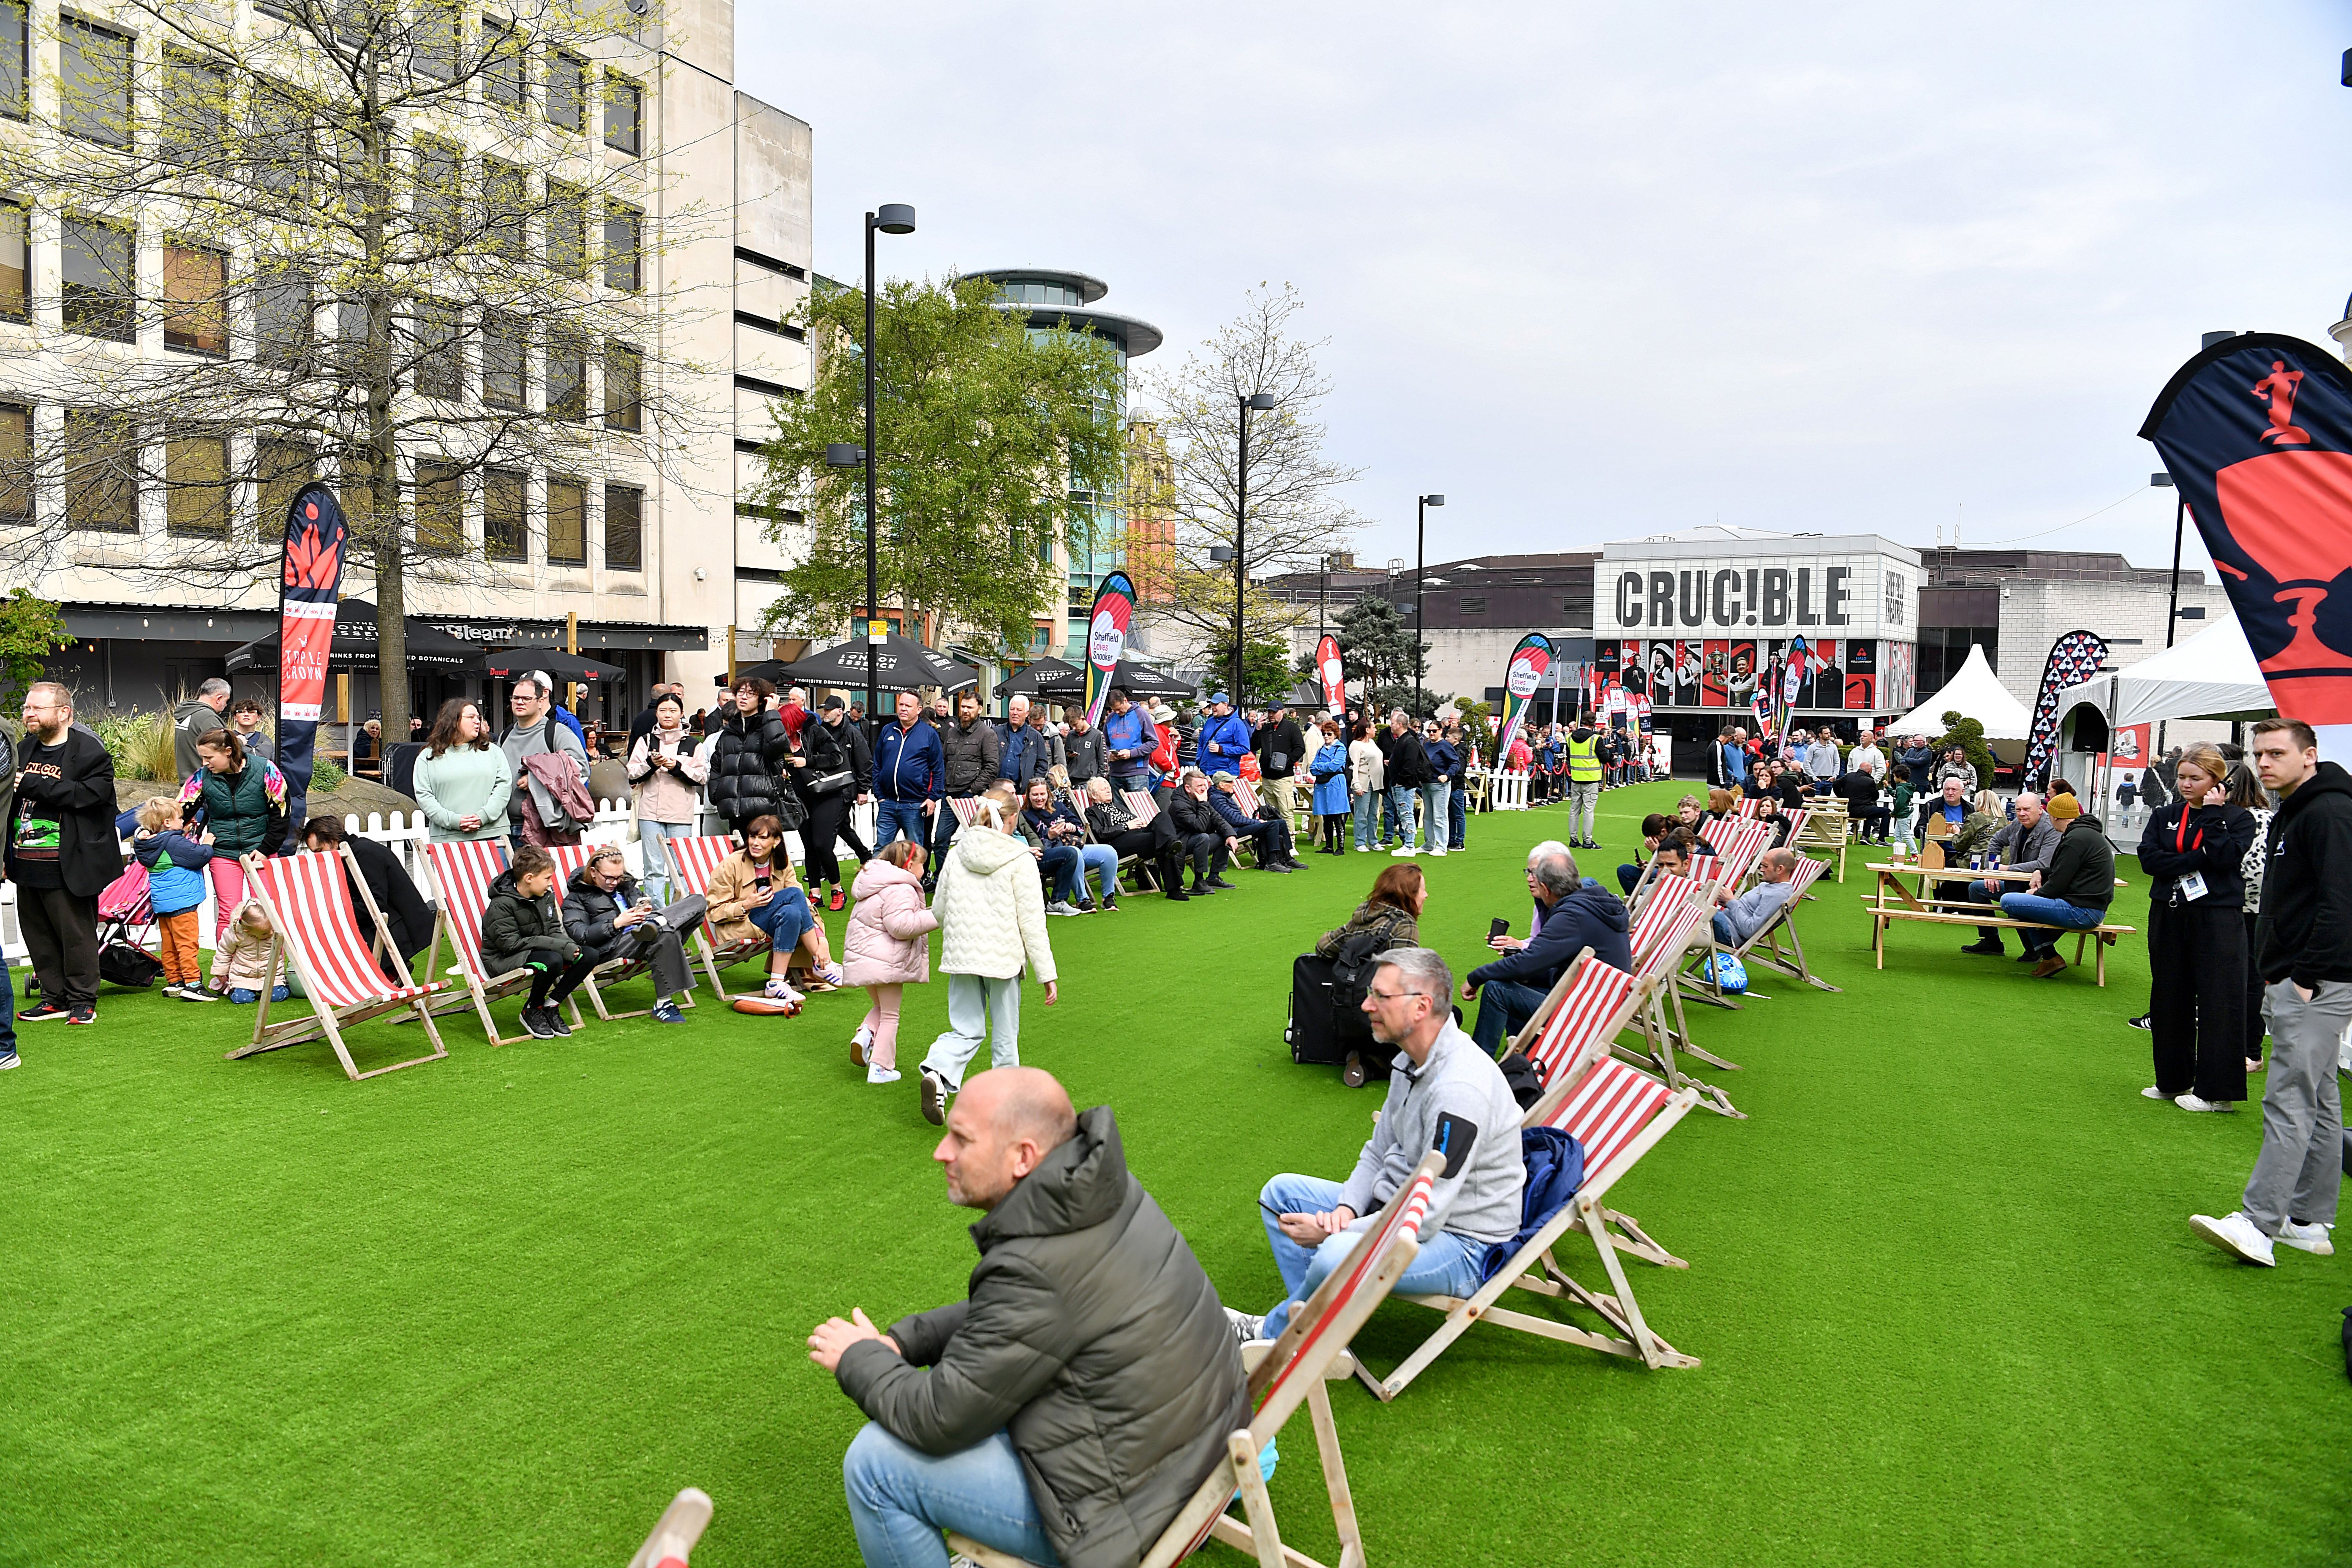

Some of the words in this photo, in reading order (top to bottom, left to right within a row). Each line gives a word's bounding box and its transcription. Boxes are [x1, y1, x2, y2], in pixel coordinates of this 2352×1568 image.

[1616, 566, 1851, 627] CRUC!BLE
[1094, 632, 1119, 642] Sheffield
[1093, 641, 1108, 651] Loves
[841, 654, 897, 664] LONON
[1093, 651, 1113, 661] Snooker
[490, 667, 509, 675] Duvel
[1513, 672, 1536, 680] Sheffield
